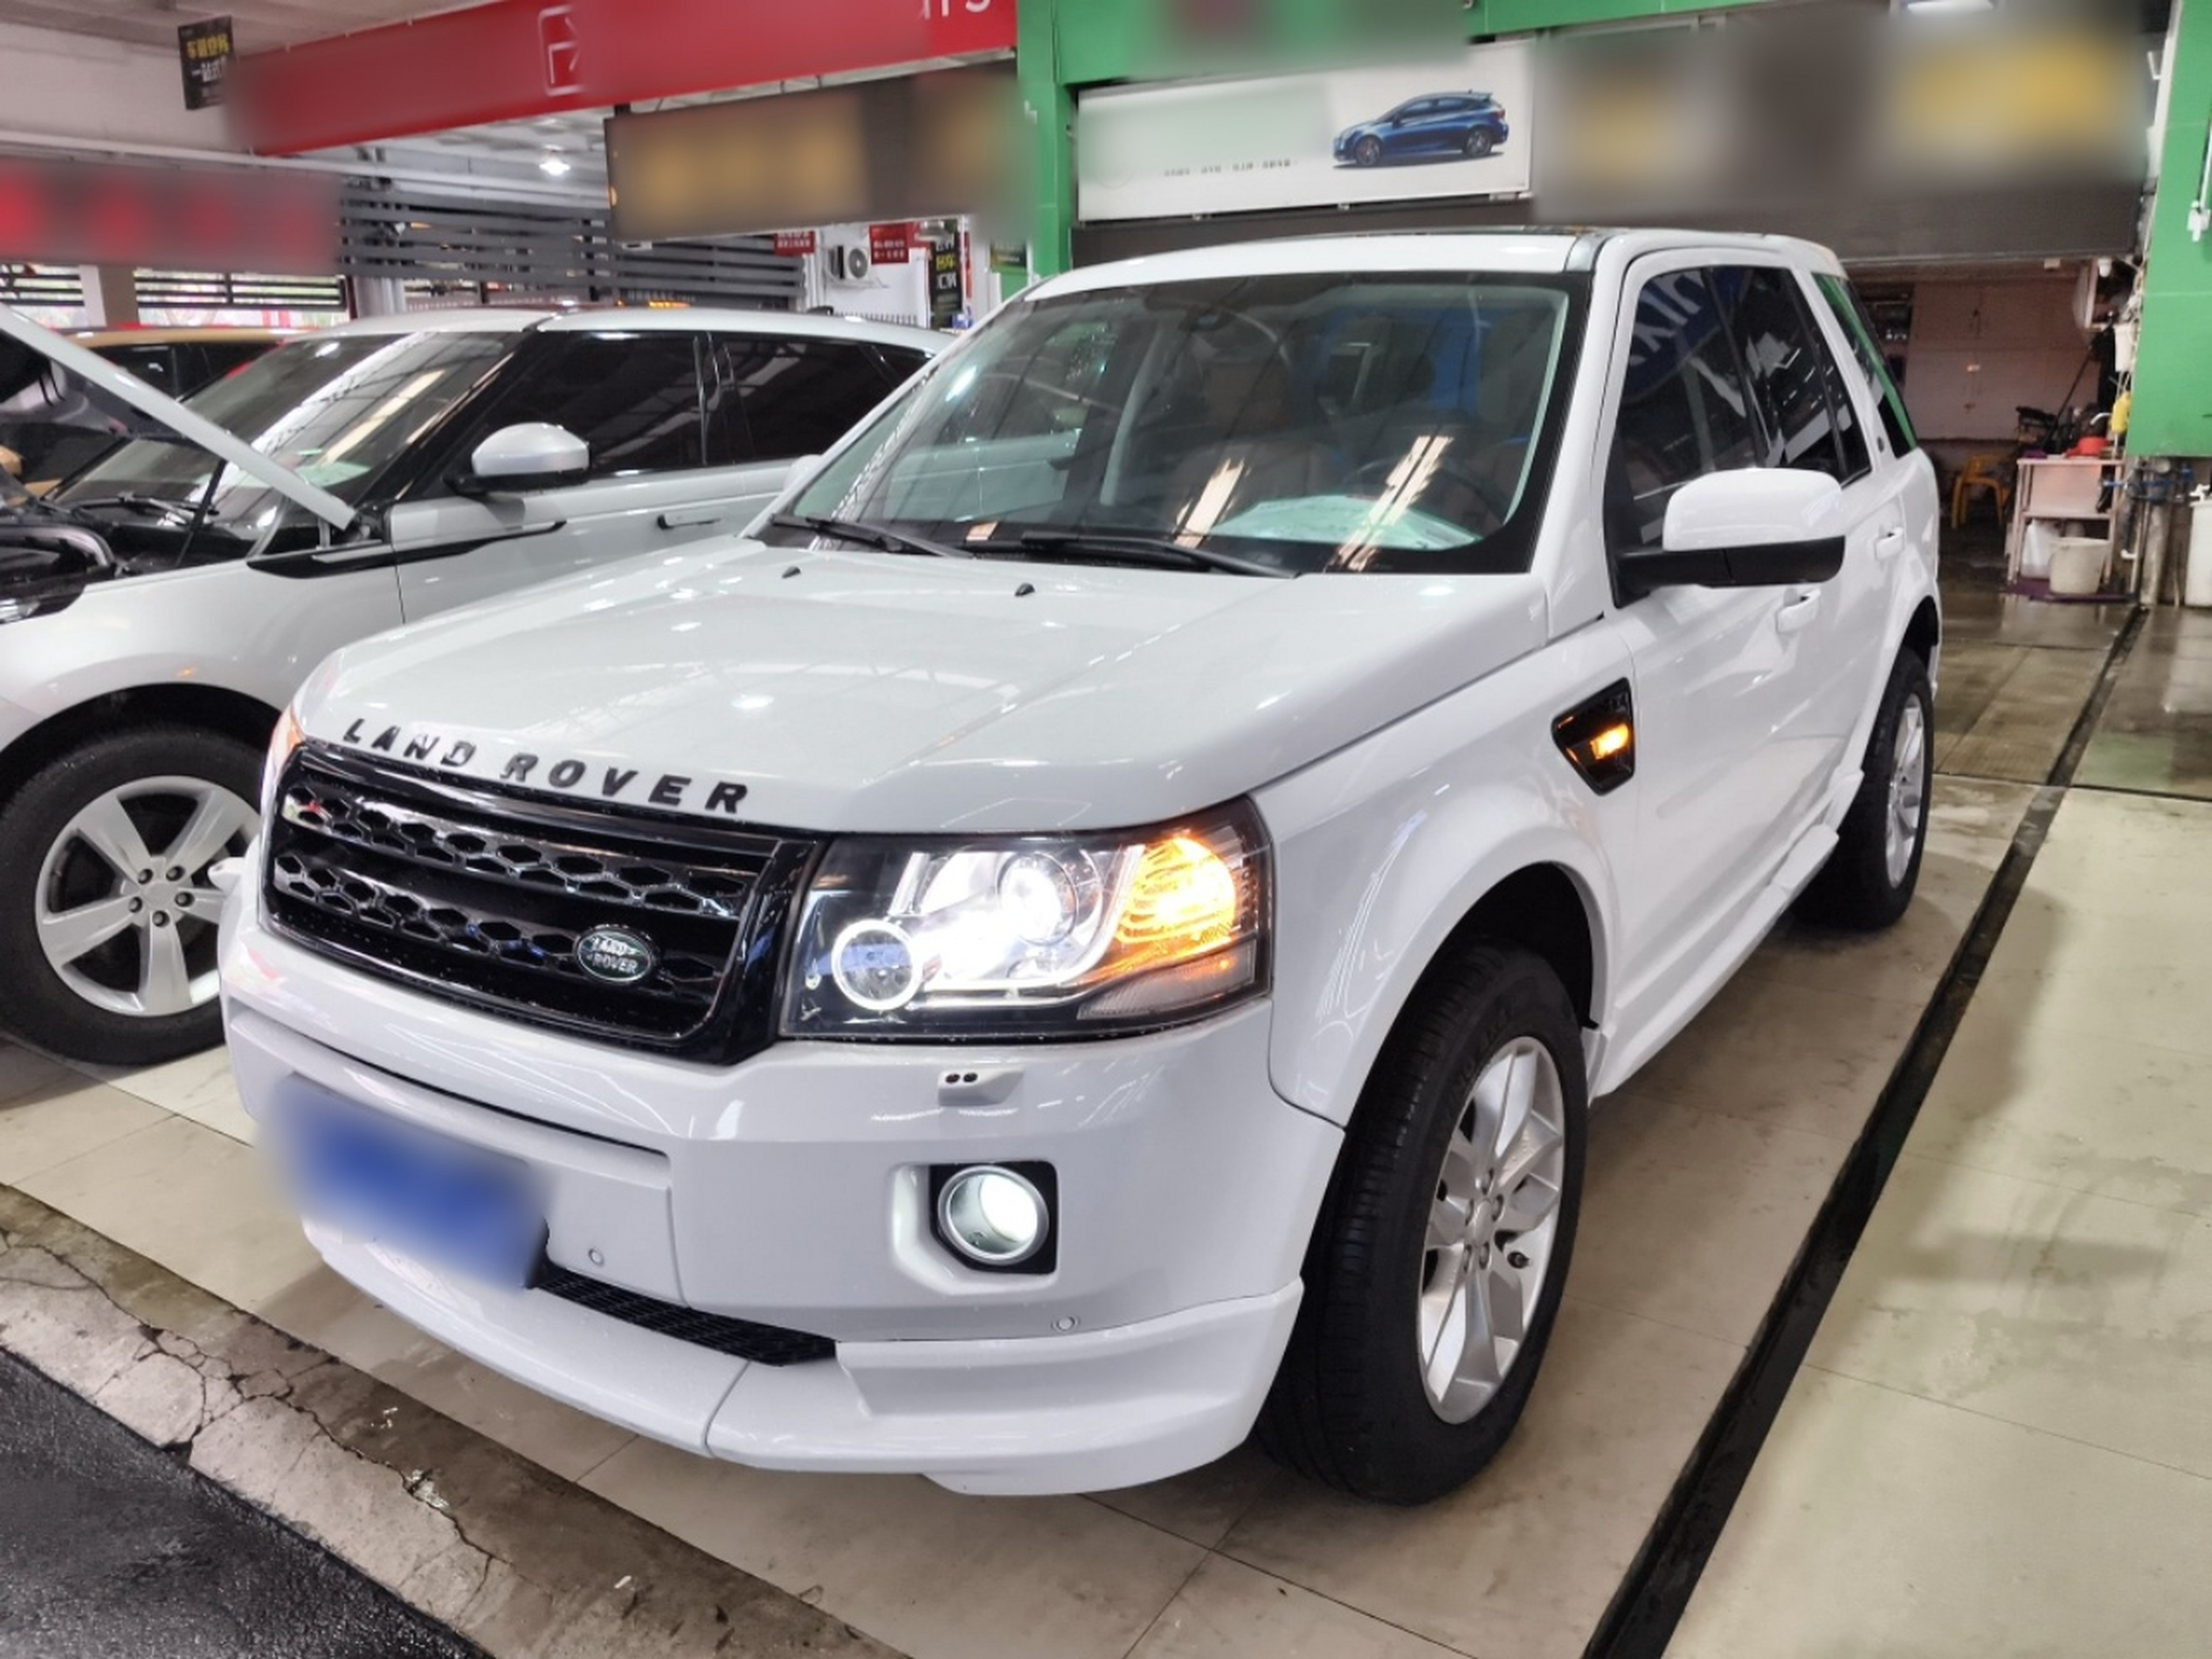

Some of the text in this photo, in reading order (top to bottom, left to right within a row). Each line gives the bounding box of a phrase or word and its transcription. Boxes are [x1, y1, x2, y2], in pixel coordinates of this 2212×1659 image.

[343, 718, 748, 814] LAND ROVER
[591, 937, 630, 957] LAND
[592, 952, 638, 975] ROVER
